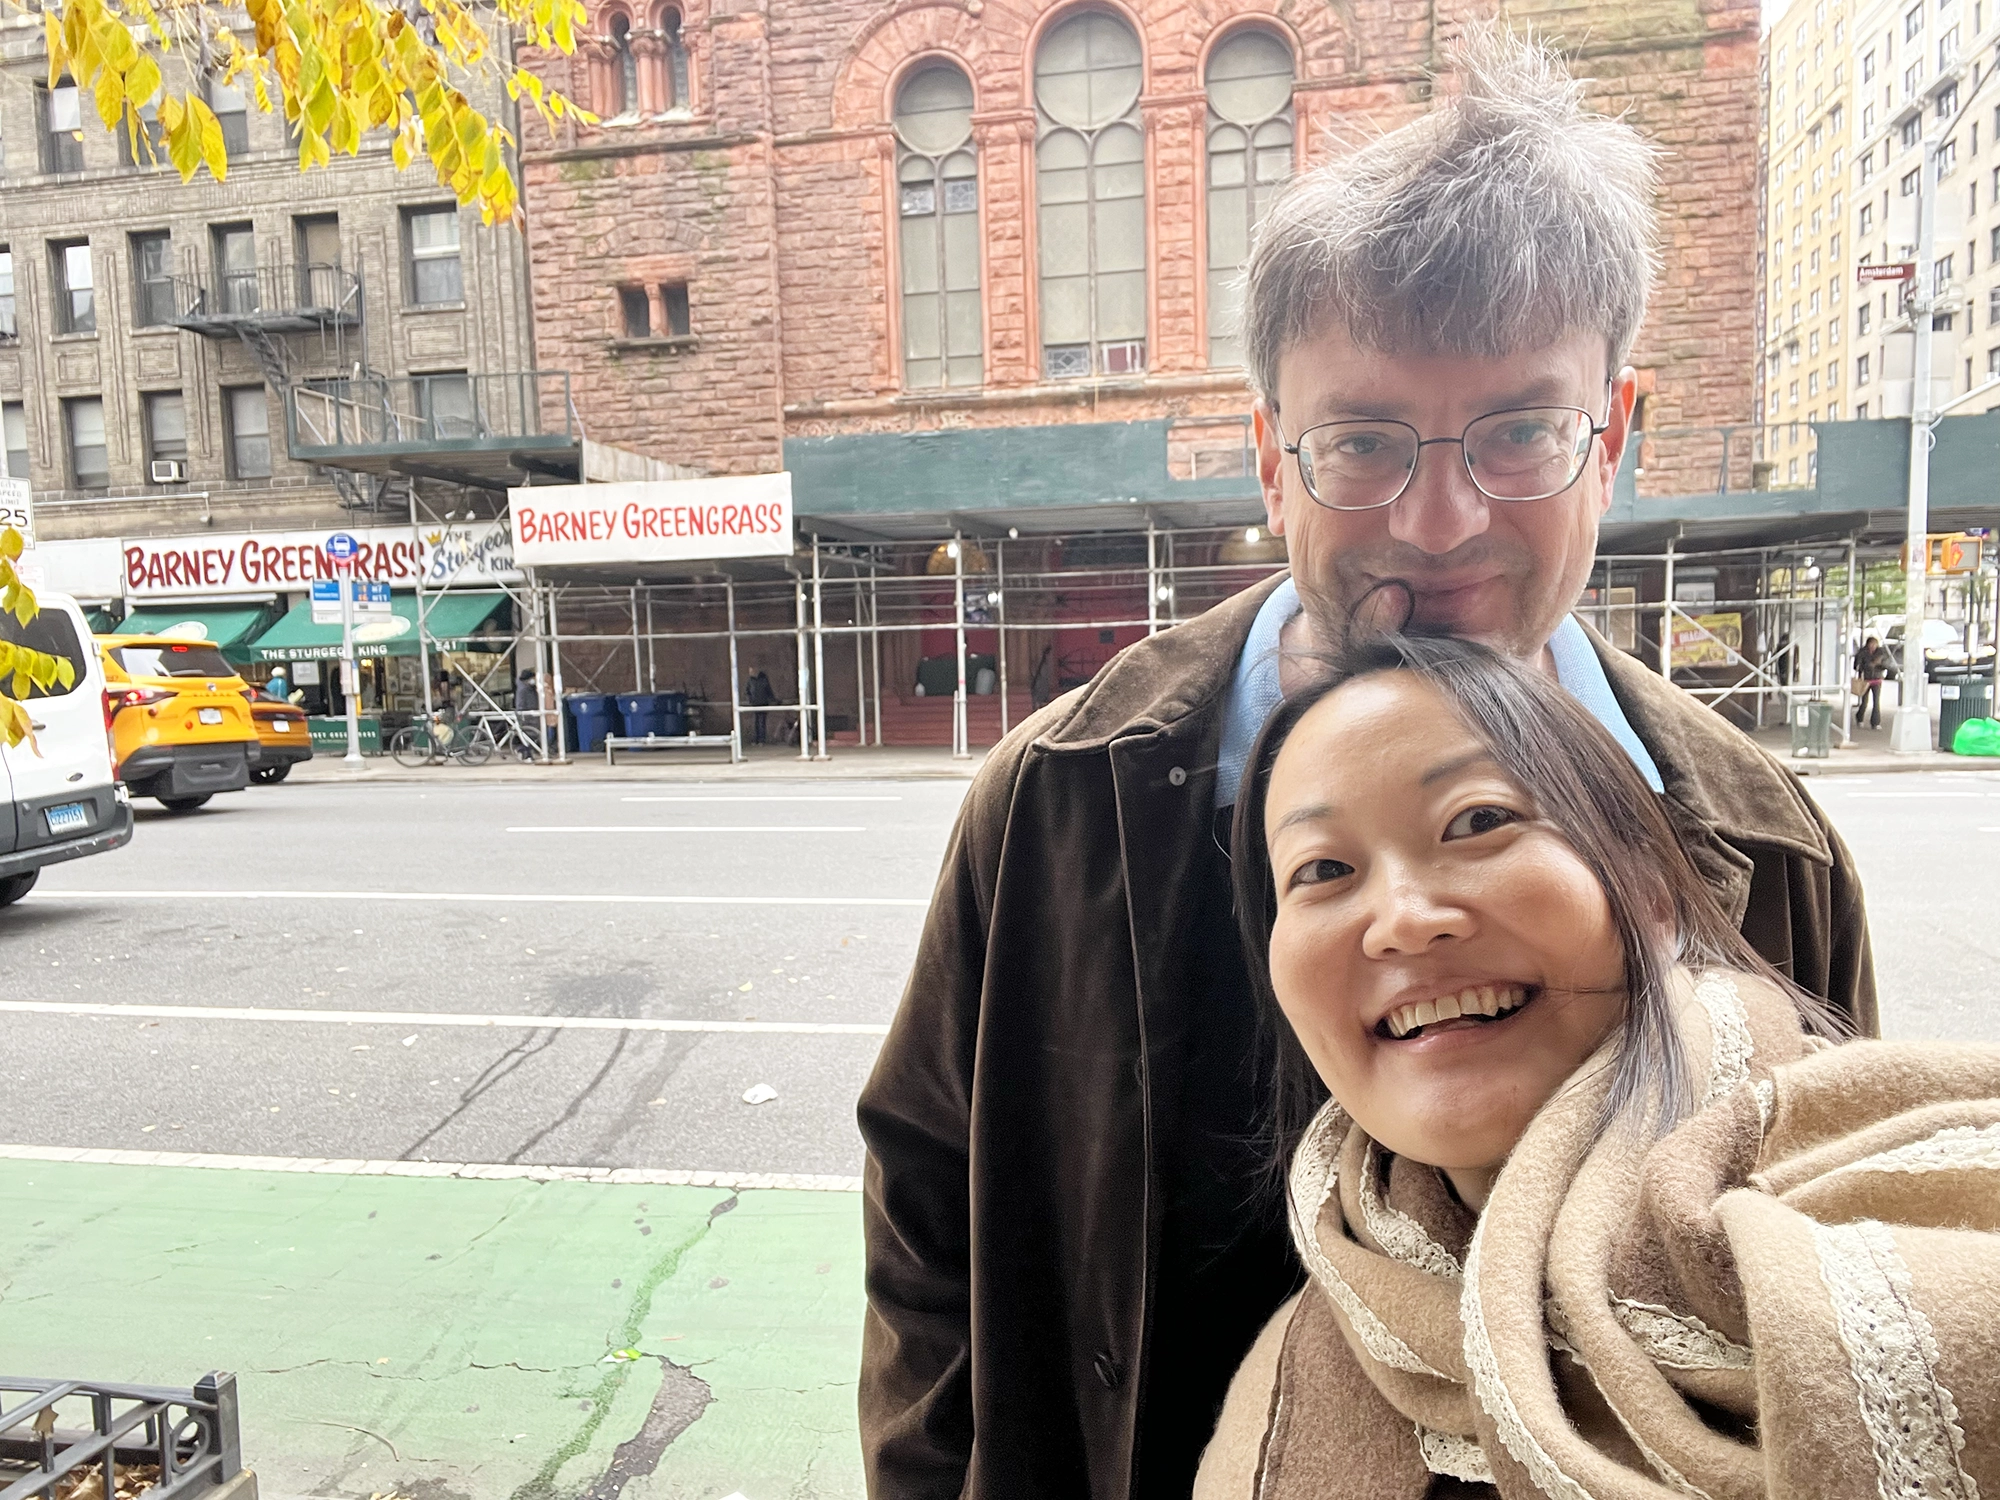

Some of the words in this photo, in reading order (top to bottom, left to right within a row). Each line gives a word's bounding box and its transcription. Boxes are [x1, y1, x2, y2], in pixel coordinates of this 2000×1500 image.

[1859, 266, 1904, 277] Amsterdam
[0, 508, 28, 527] 25
[518, 508, 617, 543] BARNEY
[623, 503, 782, 538] GREENGRASS
[124, 547, 235, 588] BARNEY
[240, 540, 425, 583] GREENRASS
[490, 556, 514, 571] KIN
[261, 649, 286, 659] THE
[289, 646, 346, 659] STURGEO
[358, 644, 388, 656] KING
